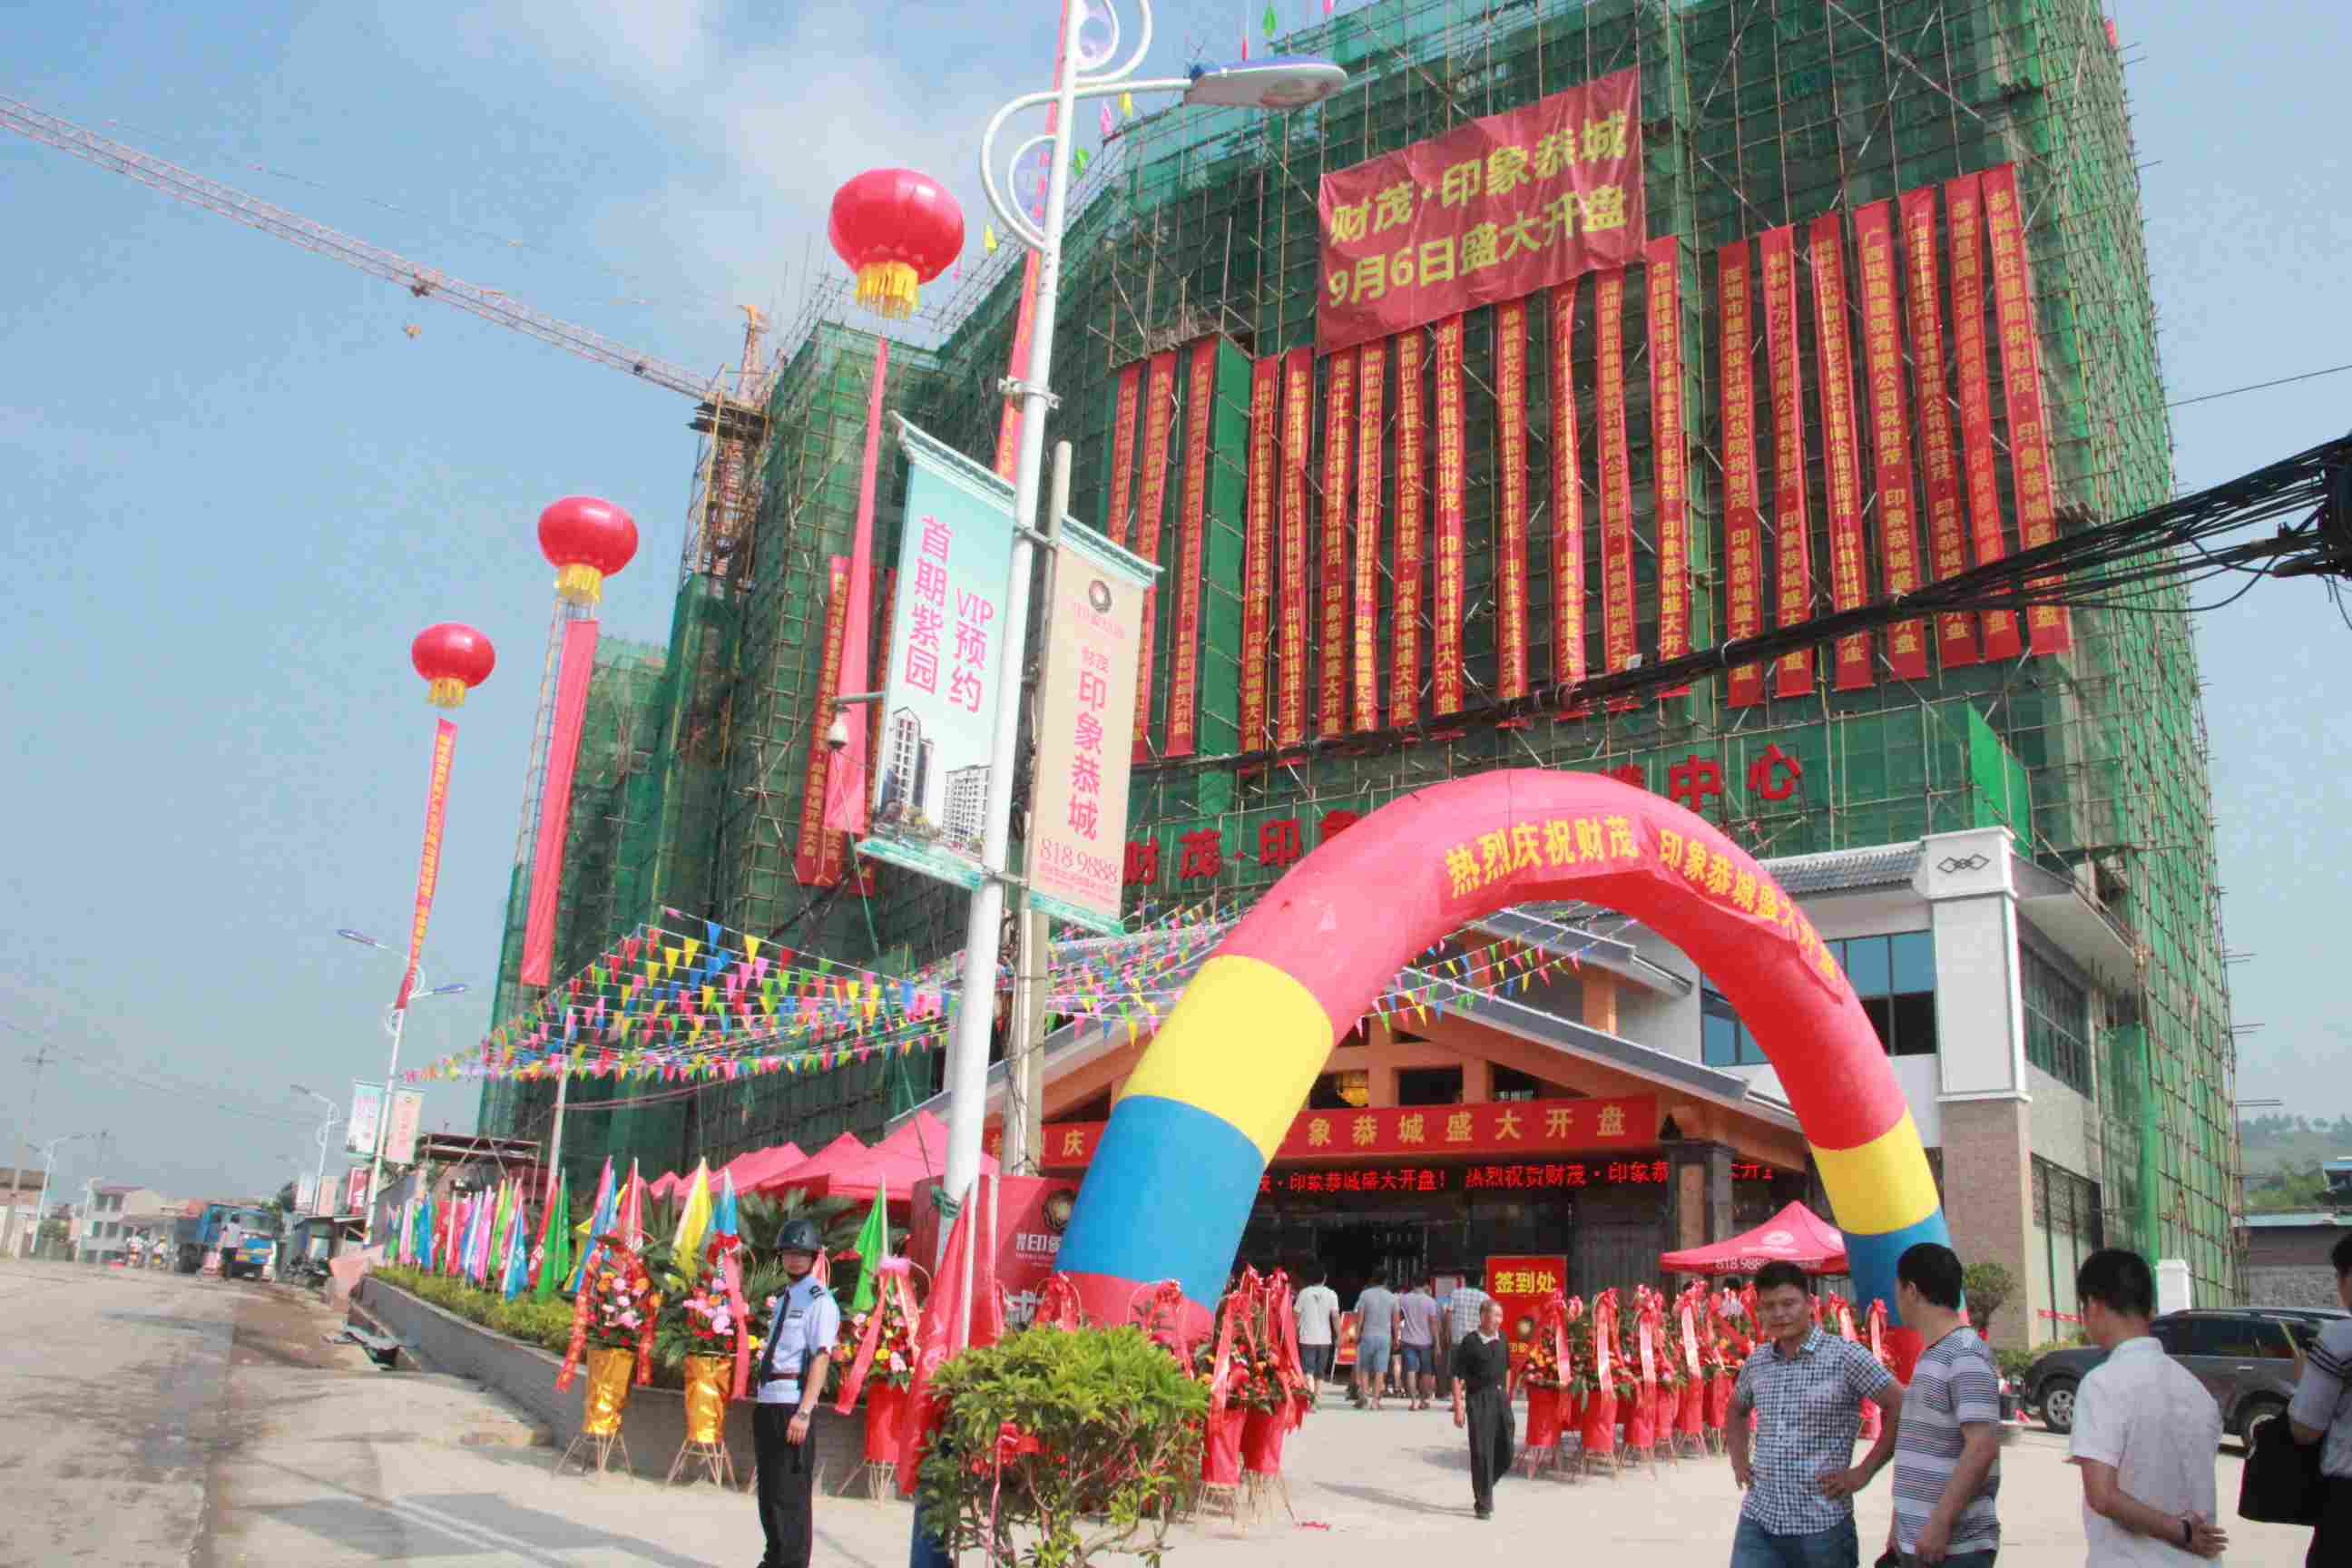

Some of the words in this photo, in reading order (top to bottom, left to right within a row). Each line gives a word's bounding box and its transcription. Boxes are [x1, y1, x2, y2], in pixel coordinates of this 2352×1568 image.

[1329, 109, 1628, 247] 财茂·印象恭城
[1328, 183, 1627, 307] 9月6日盛大开盘
[905, 514, 953, 696] 首期紫园
[948, 588, 995, 714] VIP预约
[1067, 671, 1108, 843] 印象恭城
[1444, 815, 1639, 900] 热烈庆祝财茂
[1061, 1129, 1086, 1158] 庆
[1308, 1103, 1626, 1147] 象恭城盛大开盘
[1494, 1270, 1556, 1294] 签到处
